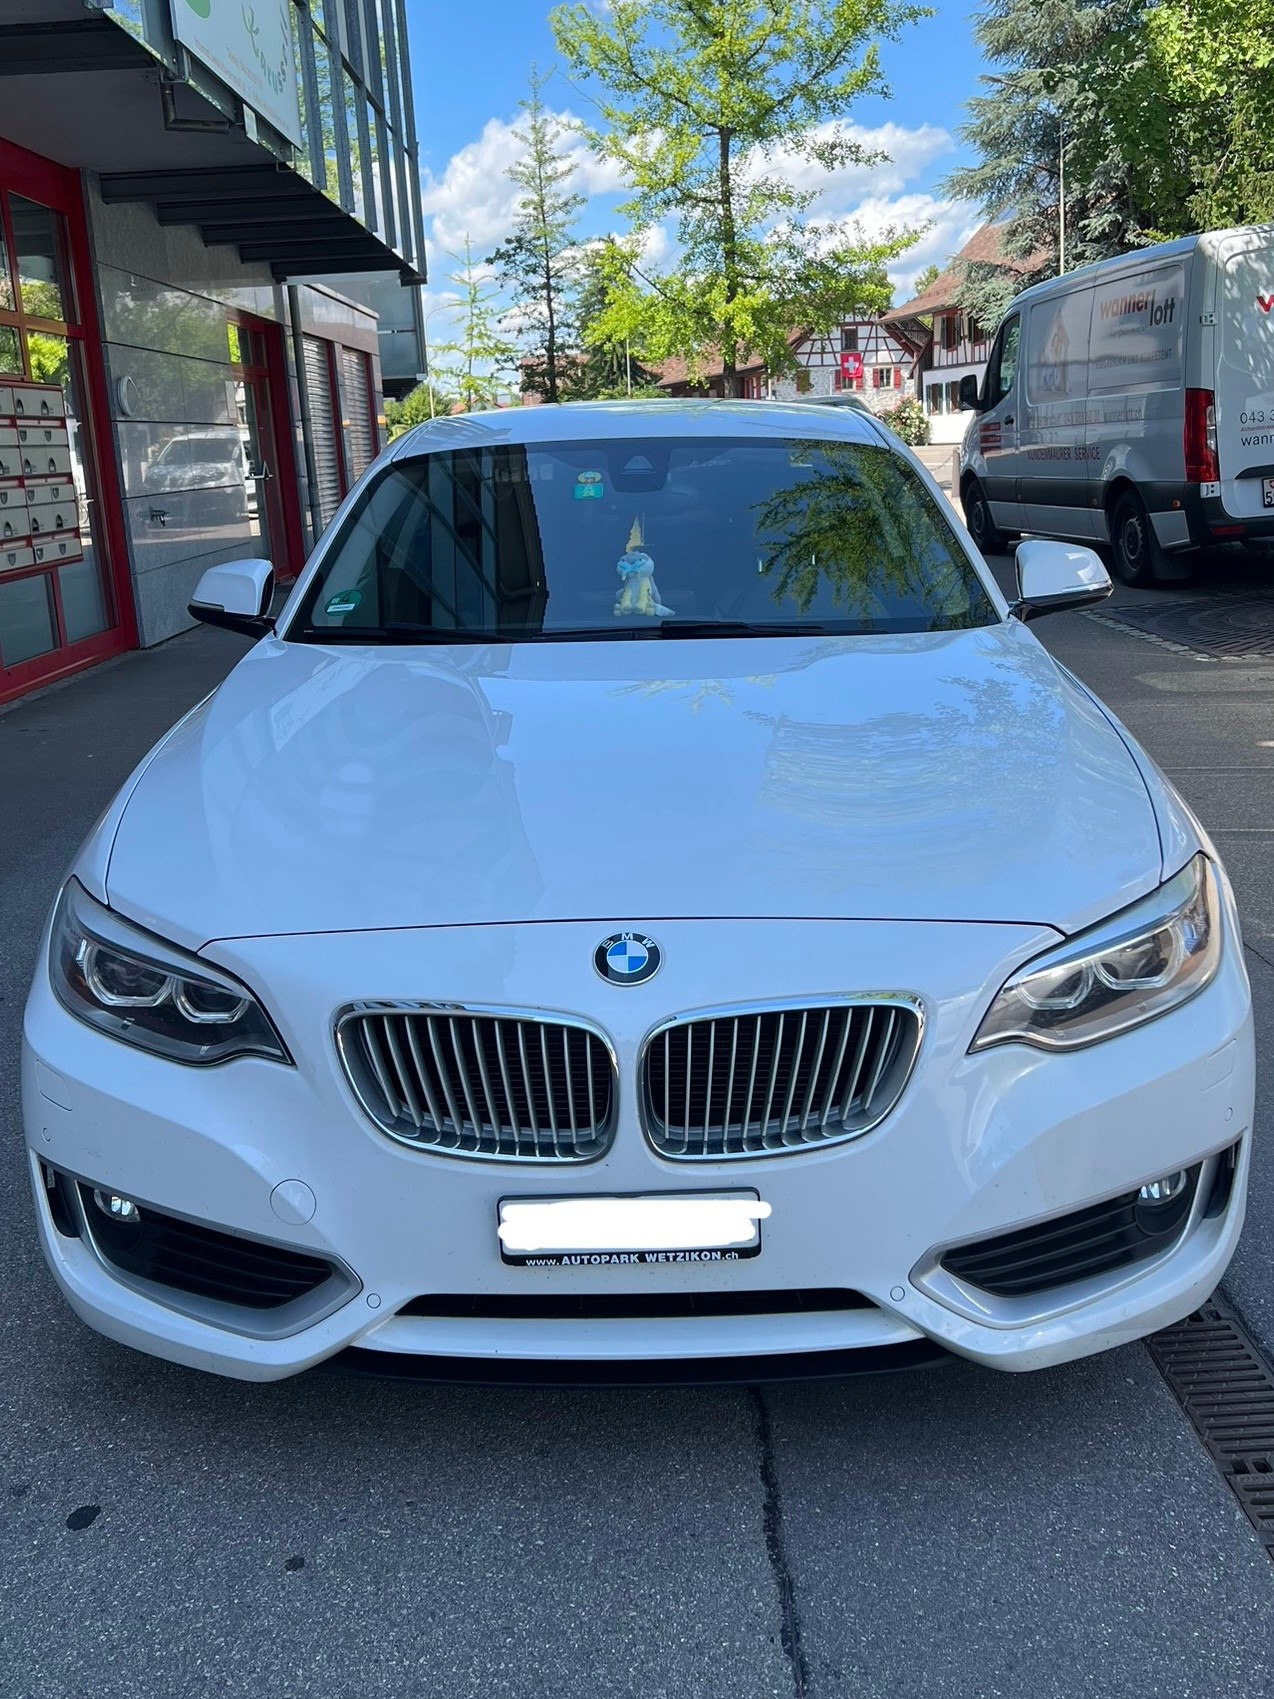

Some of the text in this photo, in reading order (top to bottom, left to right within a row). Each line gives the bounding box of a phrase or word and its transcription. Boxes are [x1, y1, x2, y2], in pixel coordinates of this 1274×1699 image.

[1240, 410, 1265, 424] 043
[601, 932, 656, 950] BMW
[525, 1251, 739, 1267] www.AUTOPARK WETZIKON.ch
